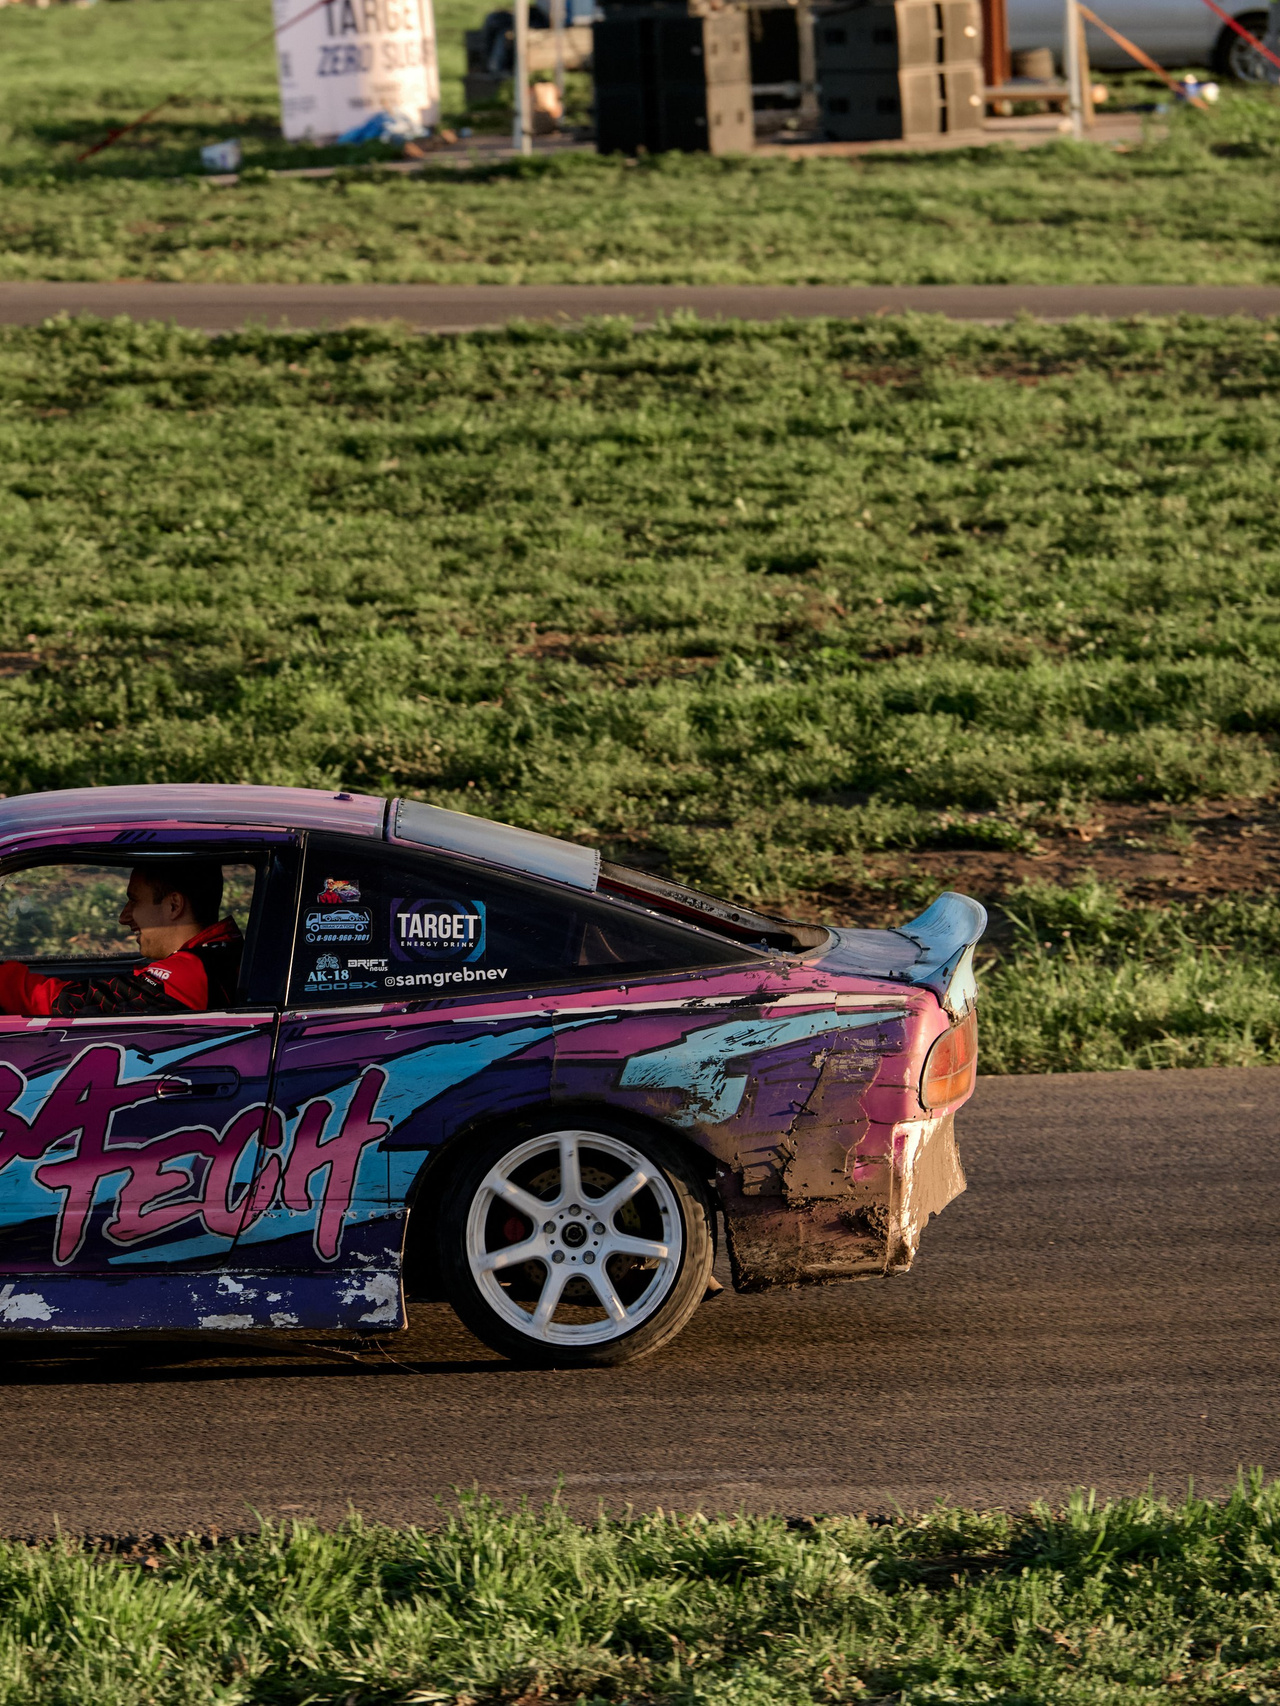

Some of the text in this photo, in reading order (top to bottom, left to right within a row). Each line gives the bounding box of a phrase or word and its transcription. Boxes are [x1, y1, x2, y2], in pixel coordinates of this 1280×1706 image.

[317, 43, 373, 77] ZERO
[397, 913, 476, 939] TARGET
[304, 980, 378, 992] 200SX
[307, 969, 350, 983] AK-18
[32, 1063, 393, 1267] TECH
